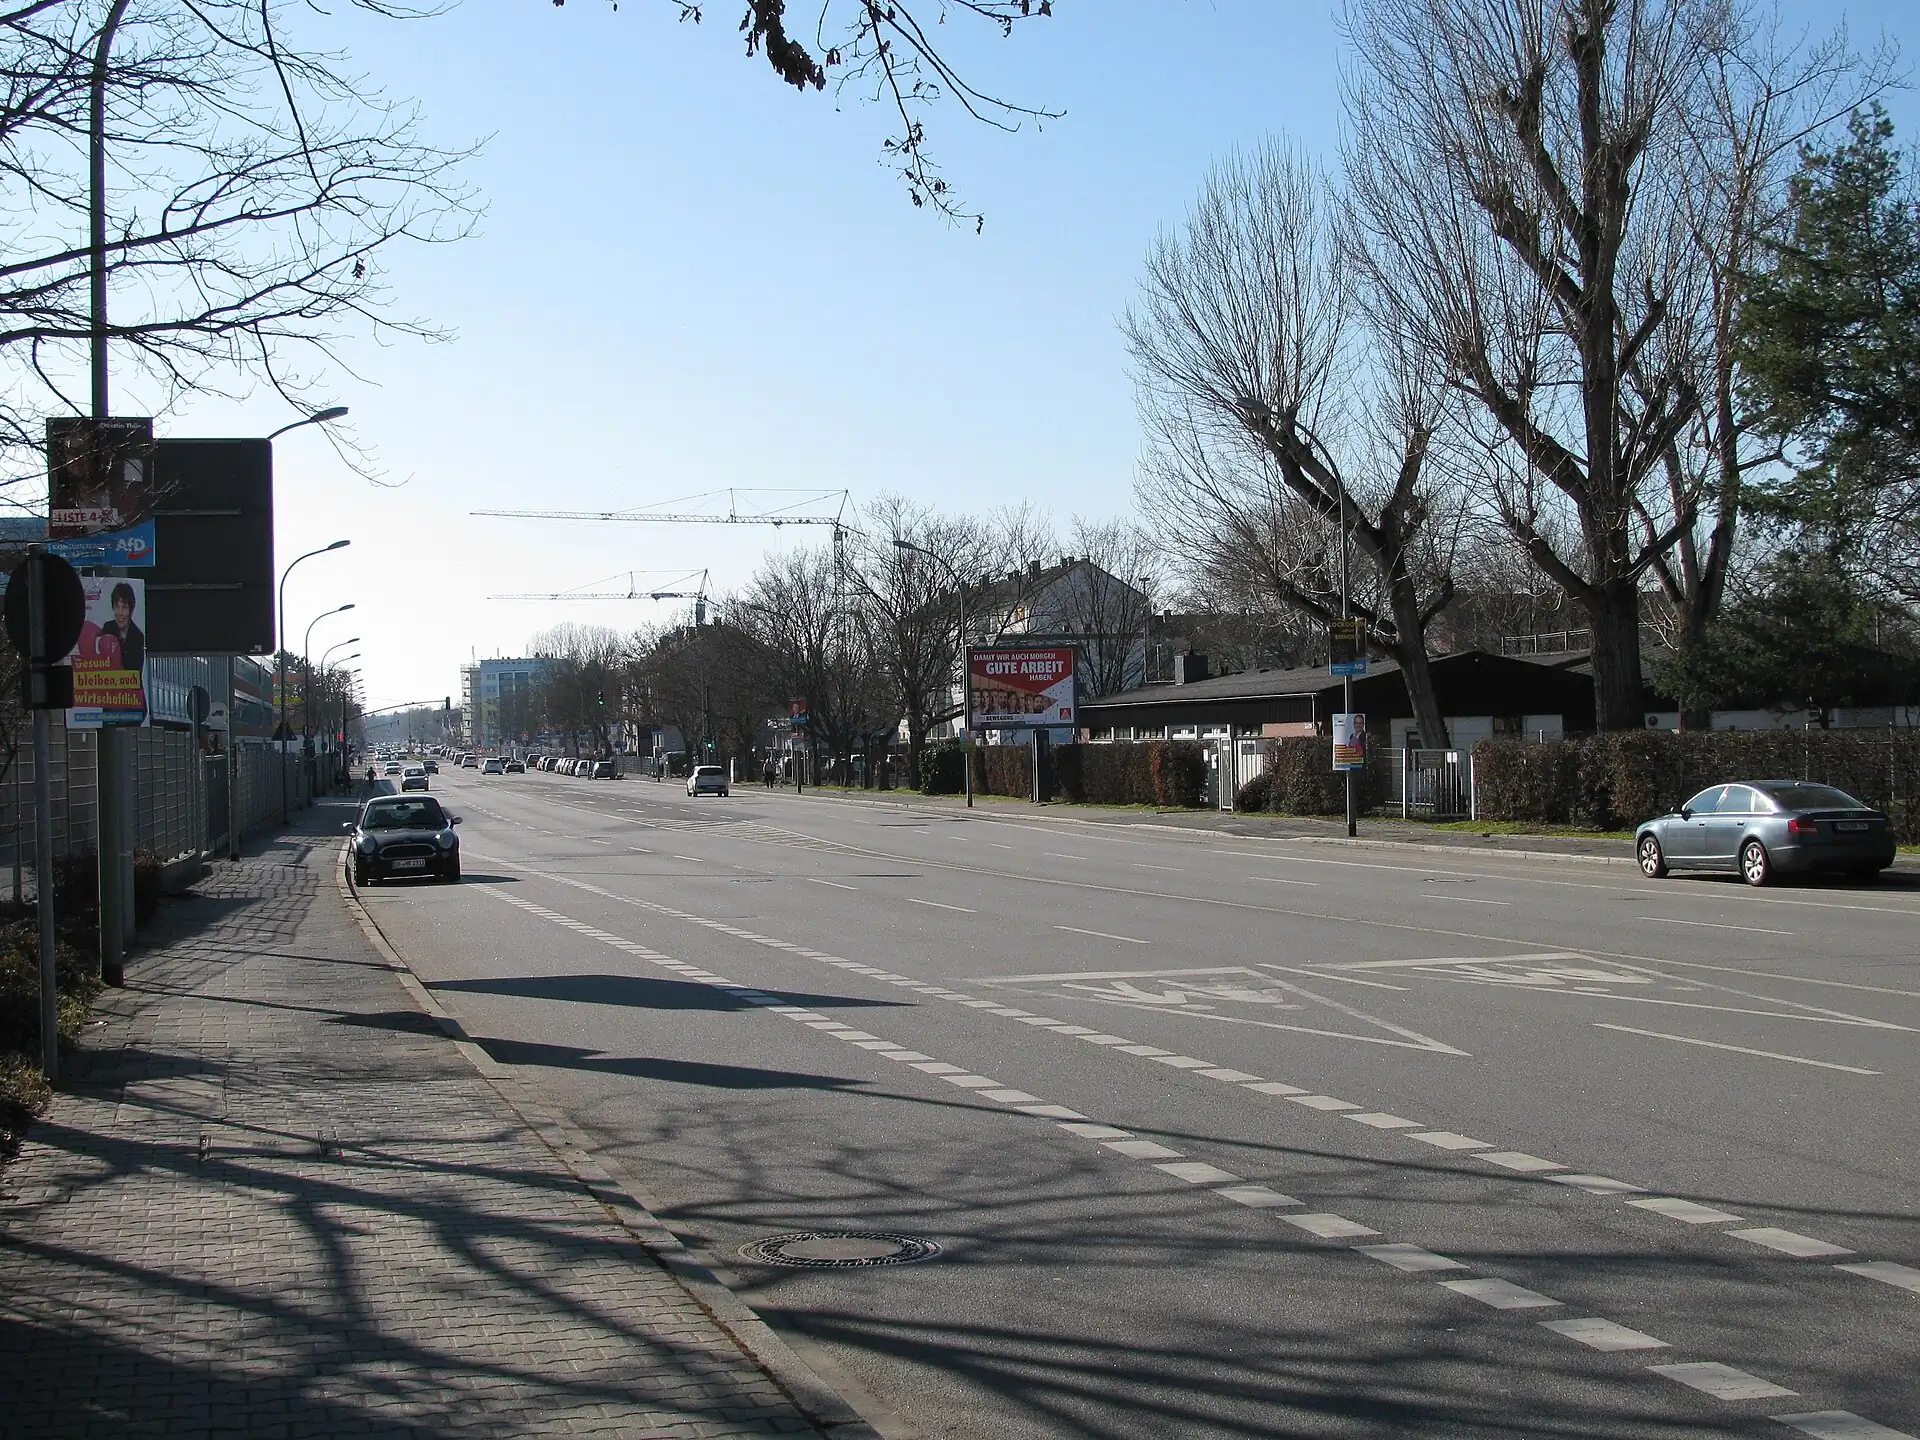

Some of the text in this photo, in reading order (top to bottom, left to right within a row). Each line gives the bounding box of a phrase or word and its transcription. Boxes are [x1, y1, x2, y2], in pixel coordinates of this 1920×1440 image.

[116, 537, 146, 552] AfD
[75, 657, 111, 668] Gesund
[996, 653, 1010, 661] WIR
[1029, 652, 1056, 660] MORGEN
[985, 660, 1064, 675] GUTE ARBEIT
[78, 673, 138, 686] bleiben, auch
[75, 690, 142, 706] wirtschaftlich.
